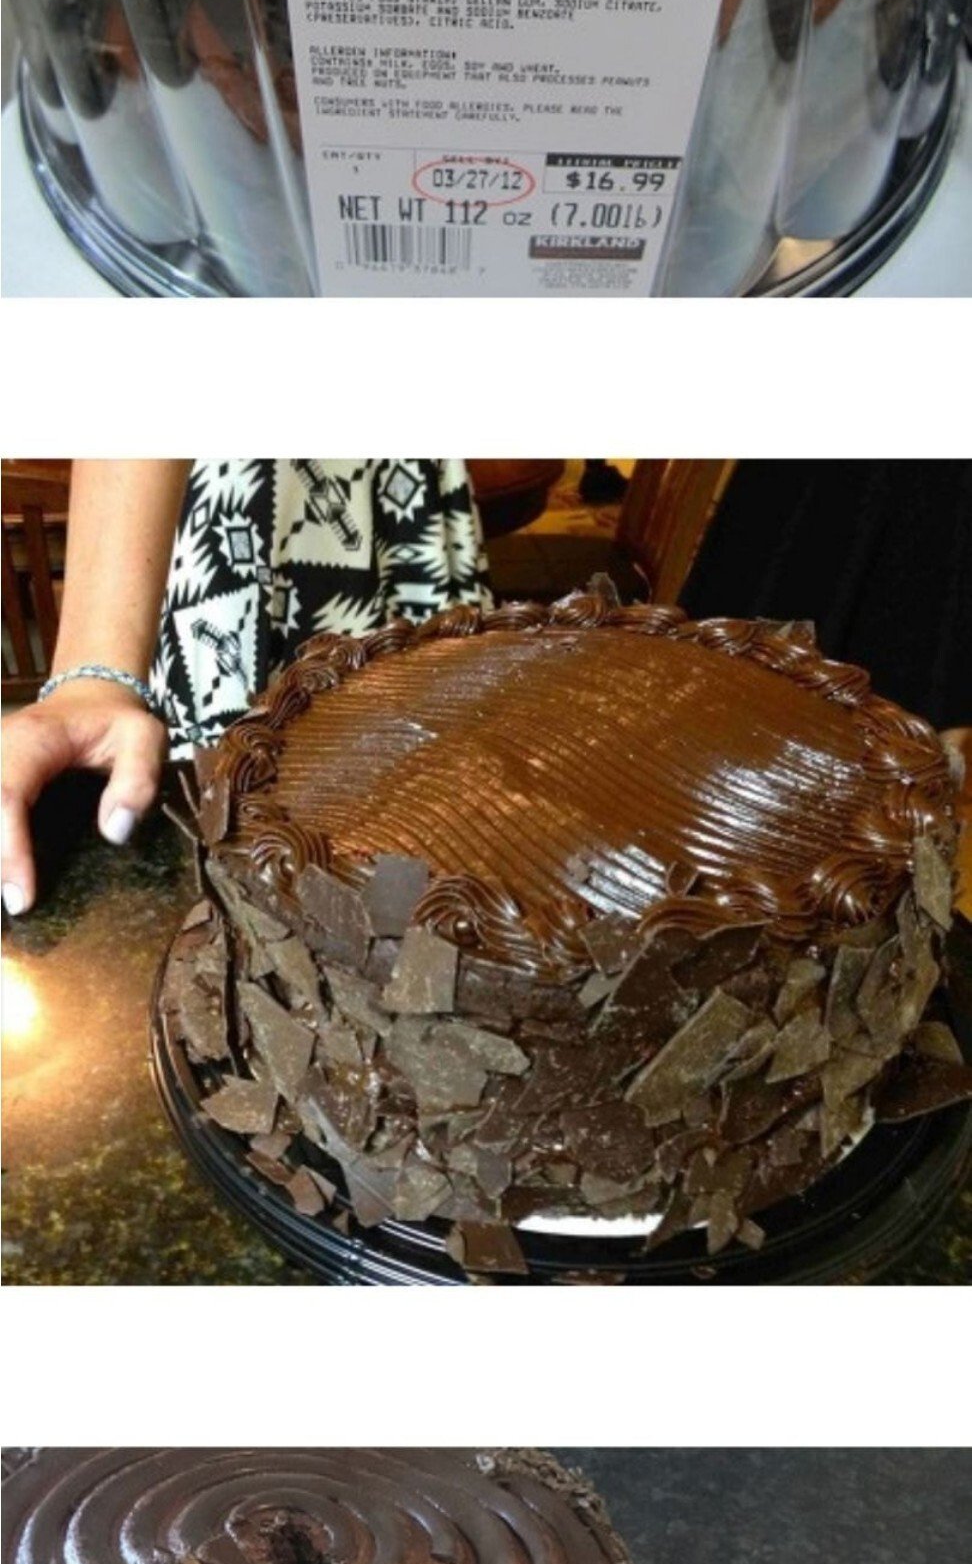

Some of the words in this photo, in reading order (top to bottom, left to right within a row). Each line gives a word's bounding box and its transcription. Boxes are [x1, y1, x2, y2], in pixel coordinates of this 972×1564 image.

[432, 168, 523, 190] 03/27/12
[566, 171, 665, 192] $16.99
[338, 195, 382, 221] NET
[399, 197, 426, 223] WT
[444, 200, 488, 226] 112
[536, 235, 640, 248] KIRKLAND
